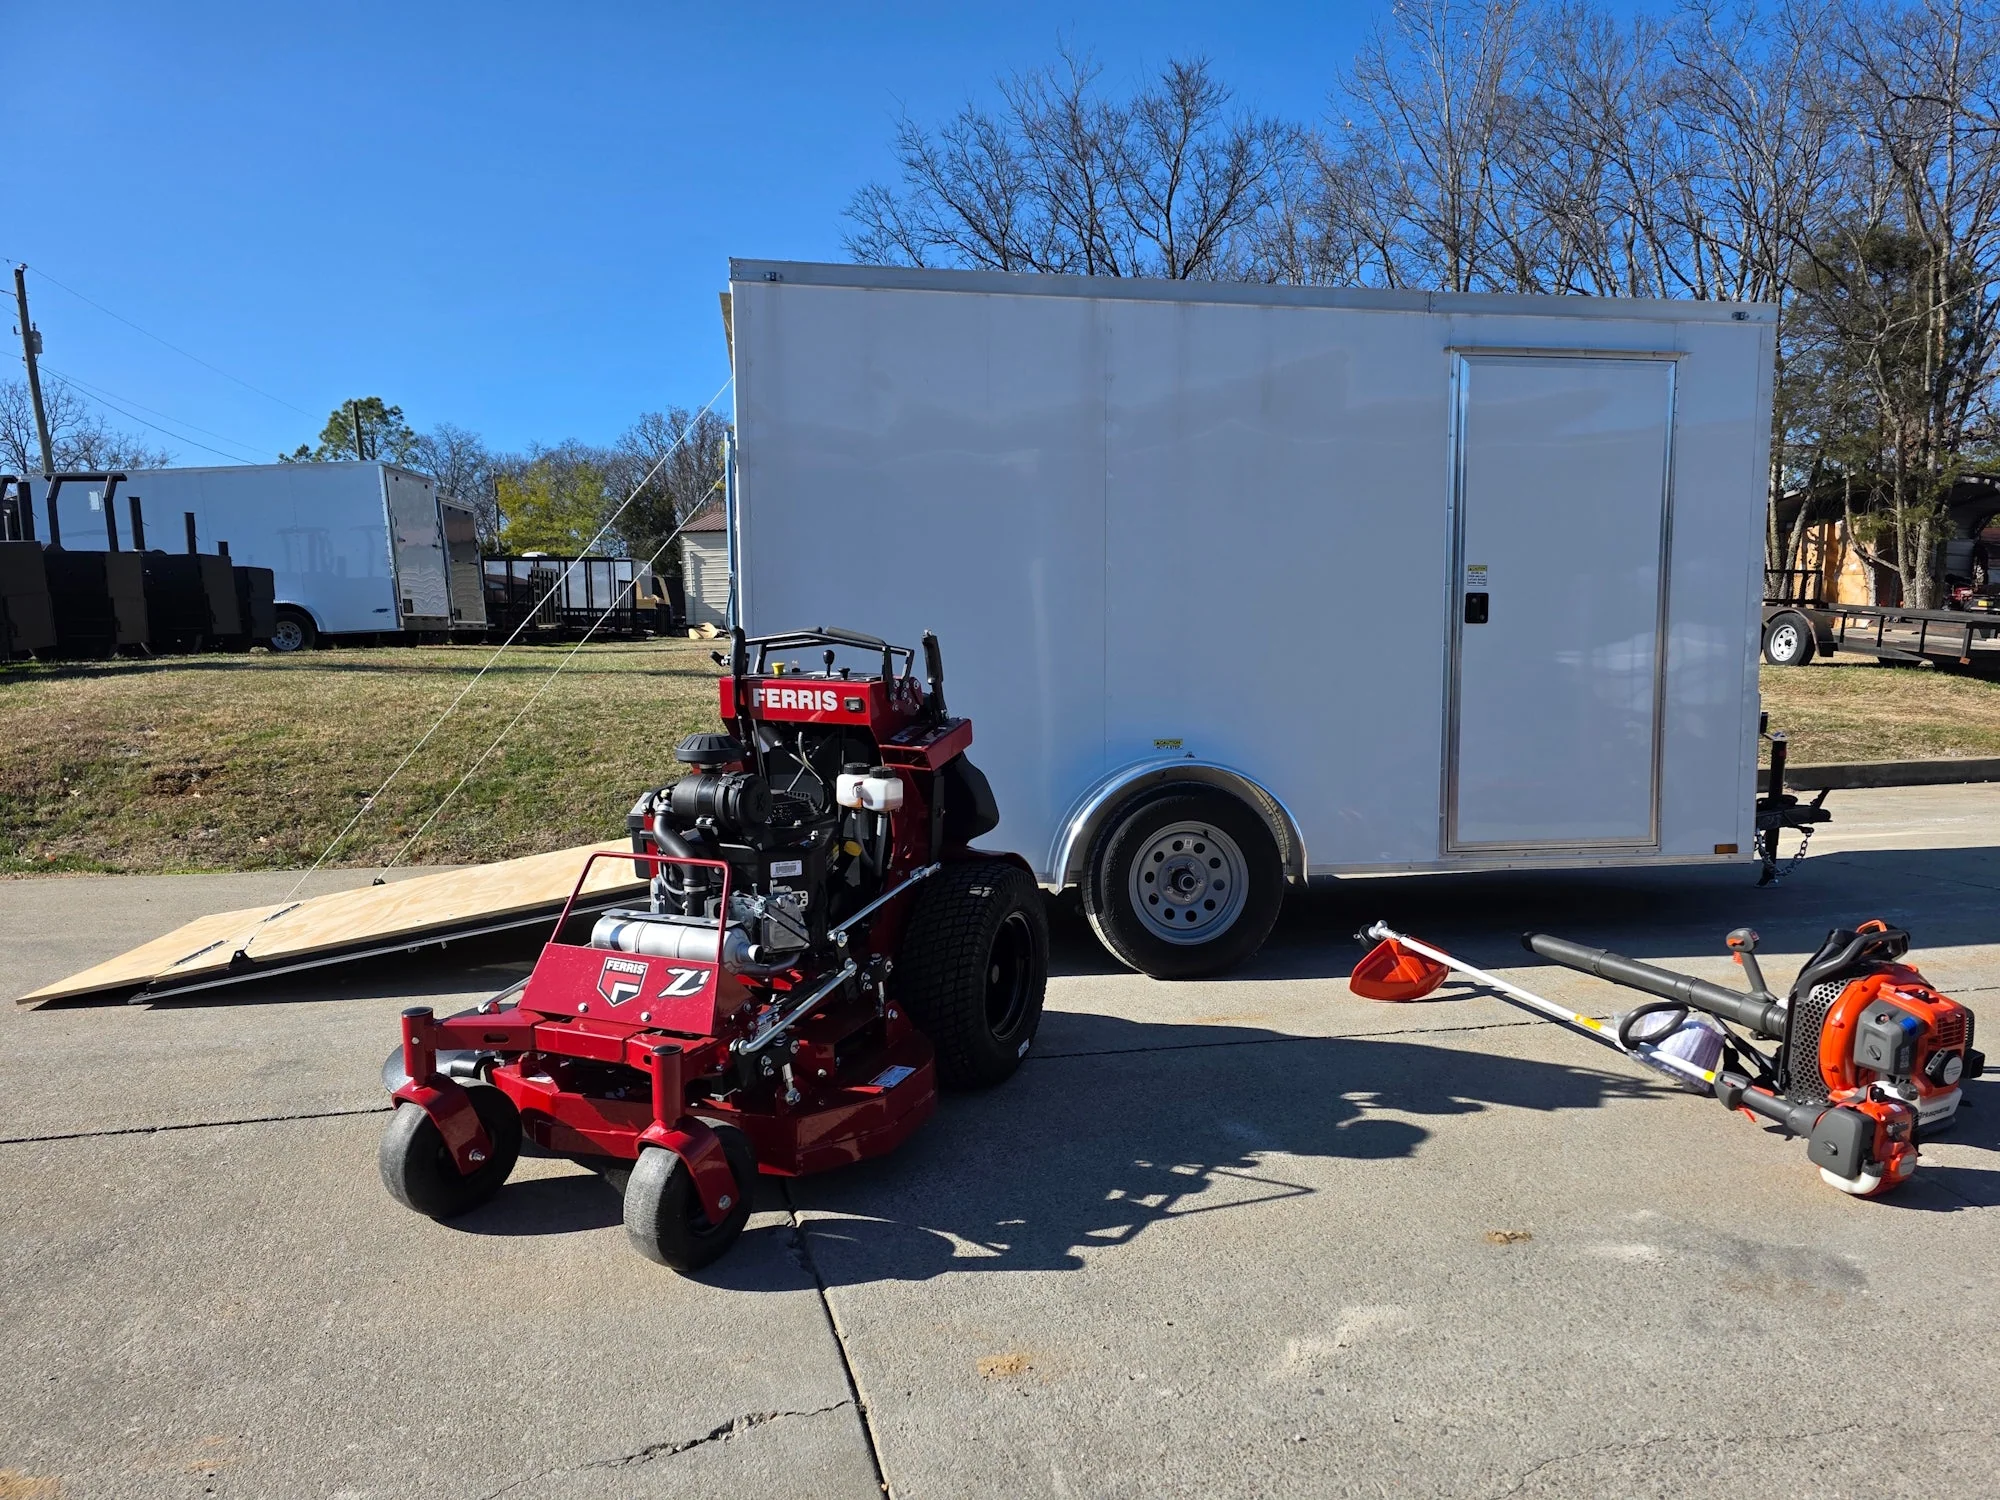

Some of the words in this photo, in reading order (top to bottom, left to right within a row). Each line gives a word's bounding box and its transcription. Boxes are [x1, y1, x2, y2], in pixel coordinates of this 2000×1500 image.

[753, 688, 838, 711] FERRIS
[606, 960, 645, 975] FERRIS
[658, 968, 711, 998] Z1
